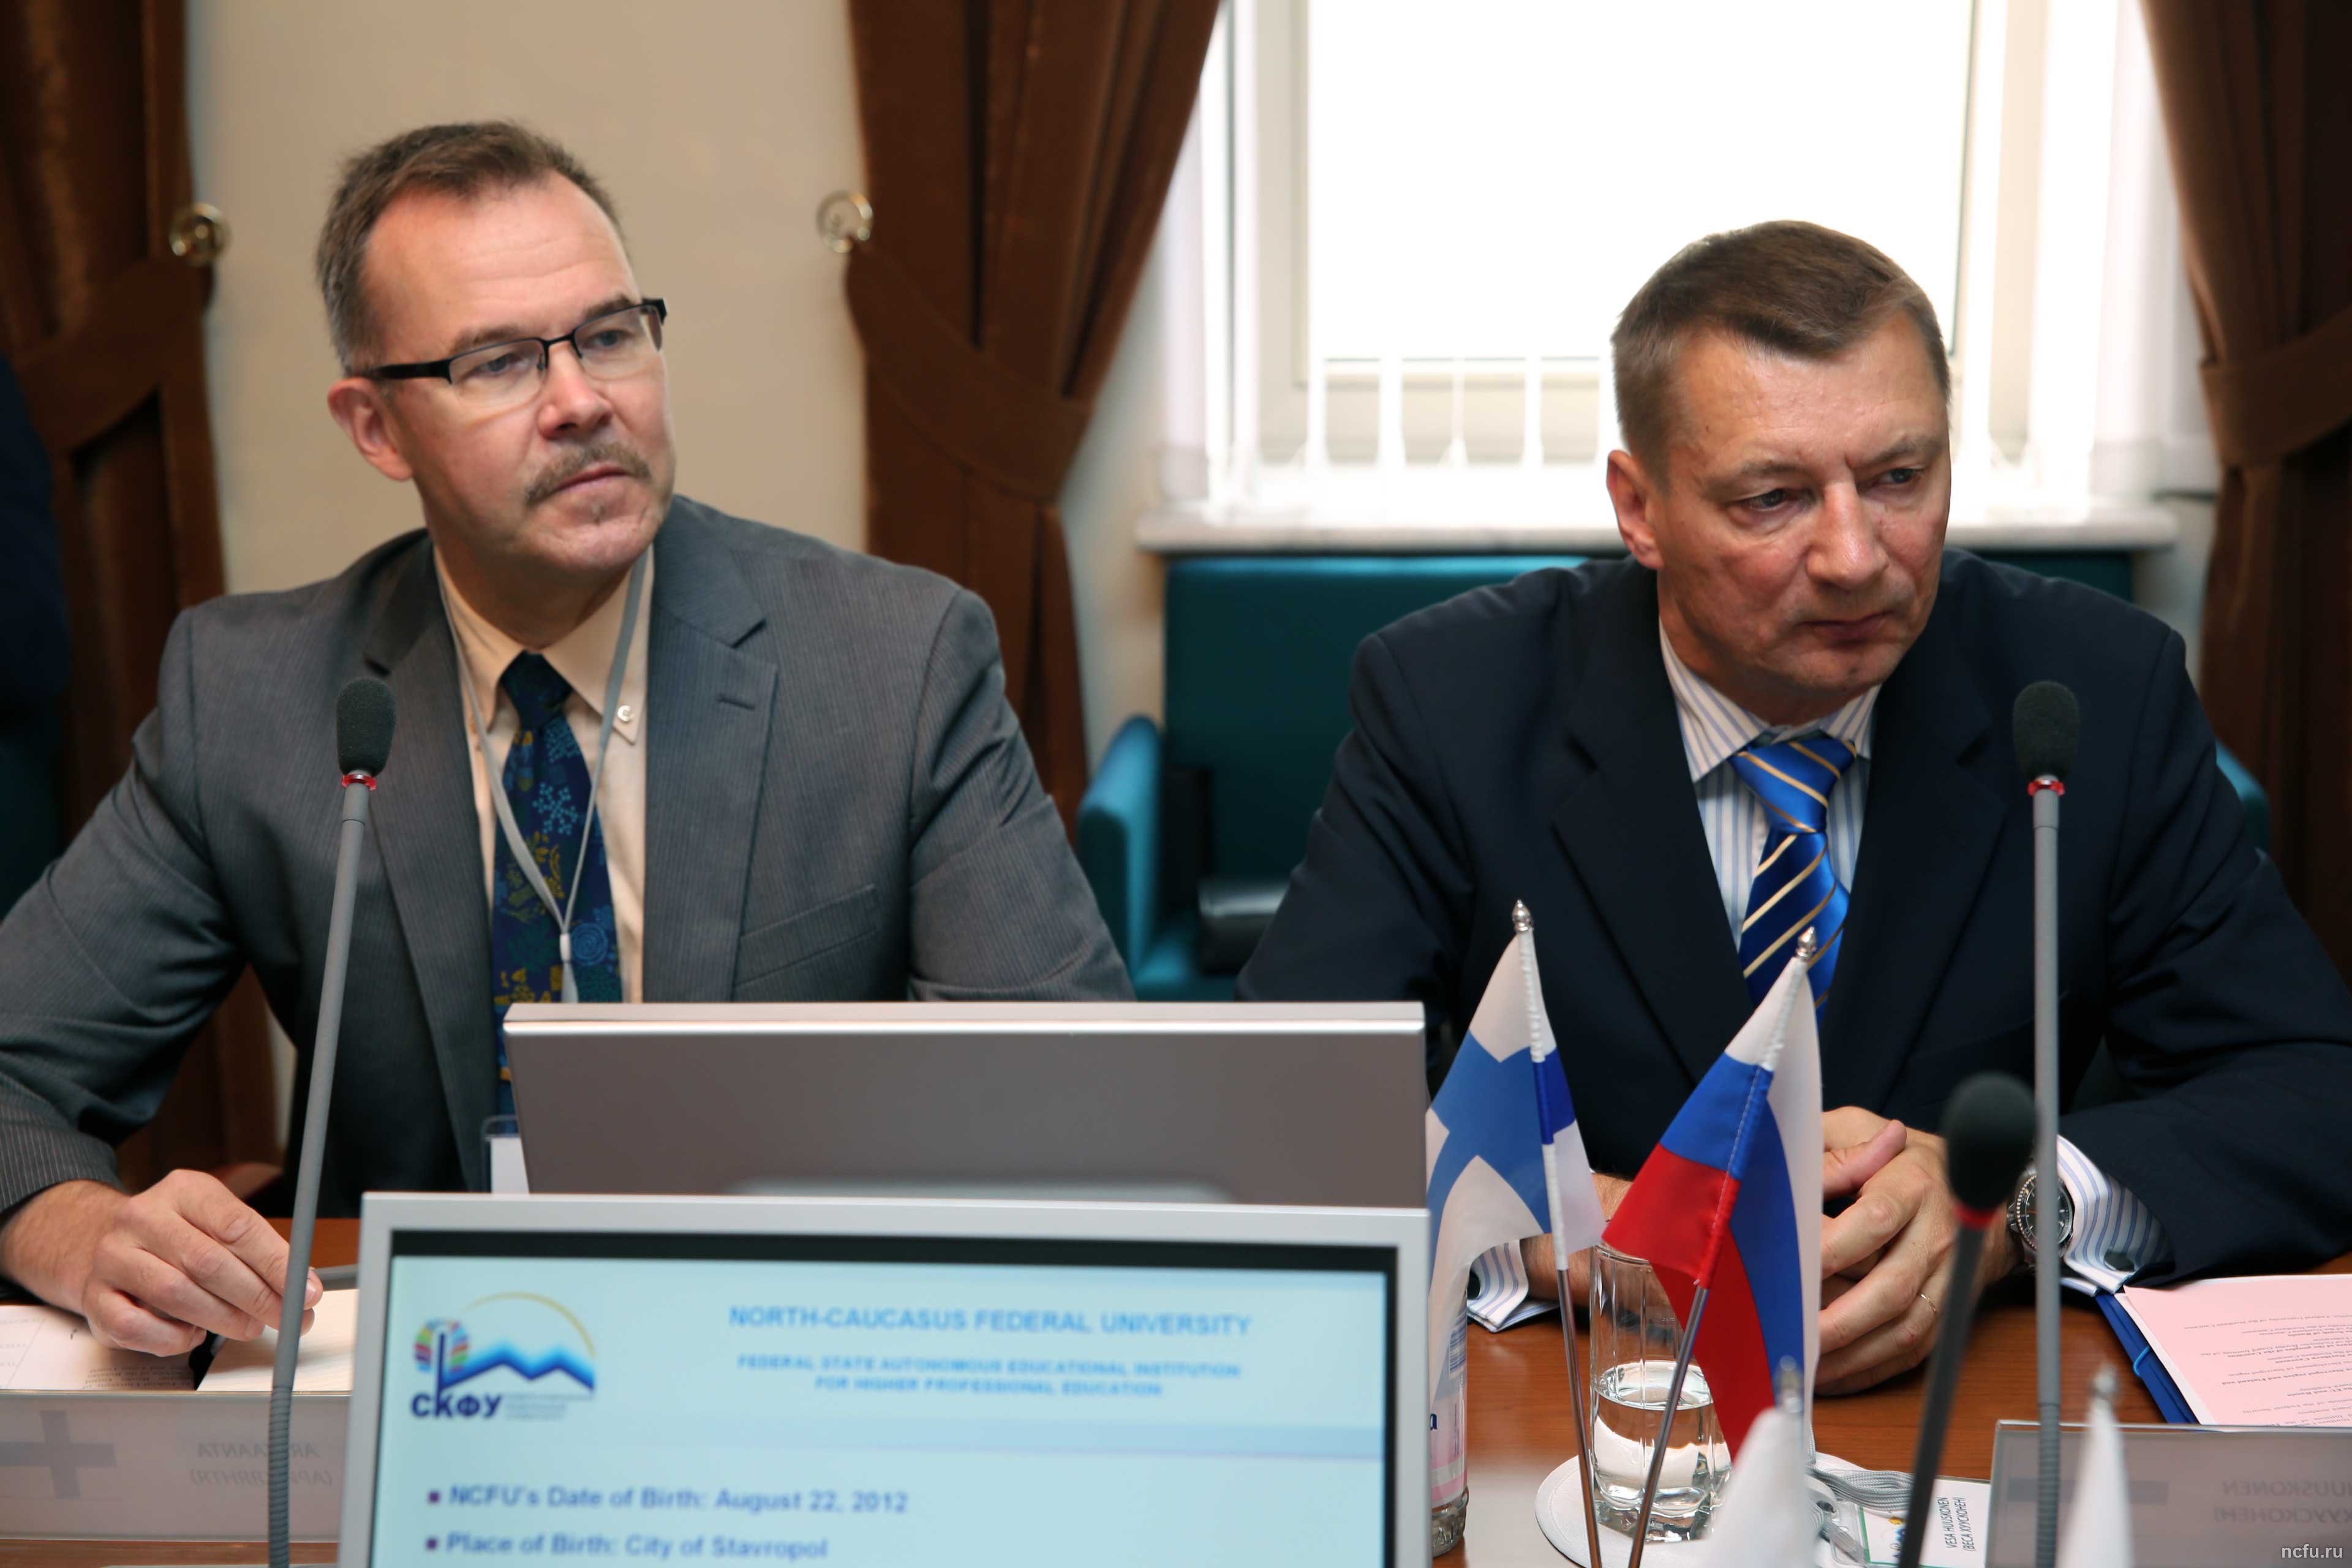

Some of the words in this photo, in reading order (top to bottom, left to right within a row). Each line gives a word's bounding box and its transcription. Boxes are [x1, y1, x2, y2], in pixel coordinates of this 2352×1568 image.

[729, 1306, 965, 1329] NORTH-CAUCASUS
[974, 1310, 1089, 1333] FEDERAL
[1100, 1313, 1252, 1335] UNIVERSITY
[737, 1355, 813, 1370] FEDERAL
[820, 1356, 873, 1370] STATE
[879, 1357, 1002, 1372] AUTONOMOUS
[1007, 1359, 1127, 1375] EDUCATIONAL
[1133, 1362, 1242, 1378] INSTITUTION
[924, 1378, 1054, 1395] PROFESSIONAL
[1061, 1381, 1163, 1396] EDUCATION
[450, 1485, 539, 1506] NCFU's
[548, 1487, 603, 1507] Date
[609, 1487, 635, 1507] of
[641, 1488, 705, 1509] Birth:
[714, 1489, 801, 1515] August
[809, 1490, 844, 1513] 22,
[851, 1491, 908, 1513] 2012
[1936, 1497, 1955, 1532] HUUSKONEN
[446, 1531, 513, 1553] Place
[518, 1533, 545, 1554] of
[551, 1534, 618, 1555] Birth:
[624, 1534, 673, 1561] City
[679, 1536, 704, 1556] of
[712, 1537, 829, 1562] Stavropol
[1944, 1533, 1958, 1548] VESA
